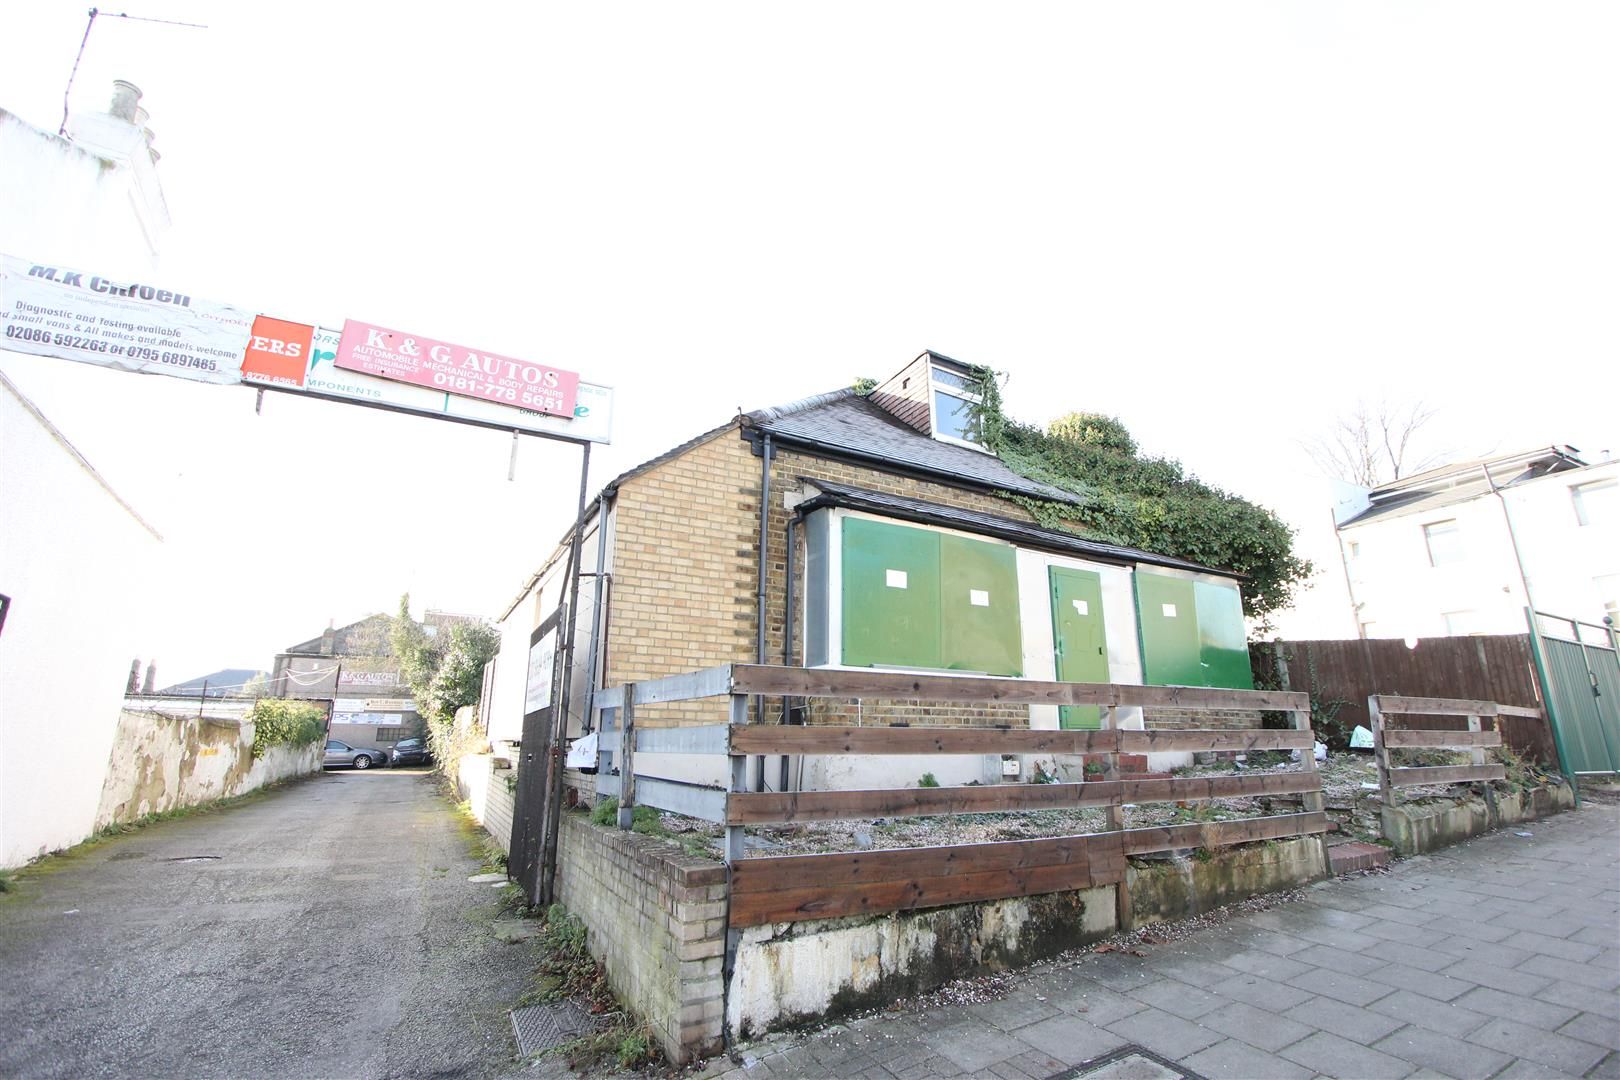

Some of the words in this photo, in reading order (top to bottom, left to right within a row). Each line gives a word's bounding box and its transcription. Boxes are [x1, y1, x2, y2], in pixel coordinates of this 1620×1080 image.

[28, 265, 82, 288] M.K
[12, 314, 44, 324] small
[46, 319, 70, 330] vans
[74, 323, 82, 332] &
[84, 325, 99, 335] All
[102, 329, 135, 341] makes
[137, 335, 157, 345] and
[195, 346, 238, 360] welcome
[15, 300, 73, 320] Diagnostic
[75, 313, 96, 324] and
[99, 317, 134, 332] Testing
[137, 324, 182, 338] available
[6, 325, 52, 344] 02086
[54, 333, 109, 352] 592263
[110, 344, 125, 355] or
[127, 346, 160, 362] 0795
[352, 352, 371, 363] FREE
[374, 358, 420, 373] INSURANCE
[398, 337, 421, 357] &
[462, 352, 560, 388] AUTOS
[353, 344, 420, 366] AUTOMOBILE
[423, 360, 485, 382] MECHANICAL
[486, 374, 494, 383] &
[499, 378, 524, 390] BODY
[526, 384, 564, 399] REPAIRS
[362, 362, 405, 377] ESTIMATES
[434, 372, 516, 400] 0181-778
[521, 391, 564, 412] 5651
